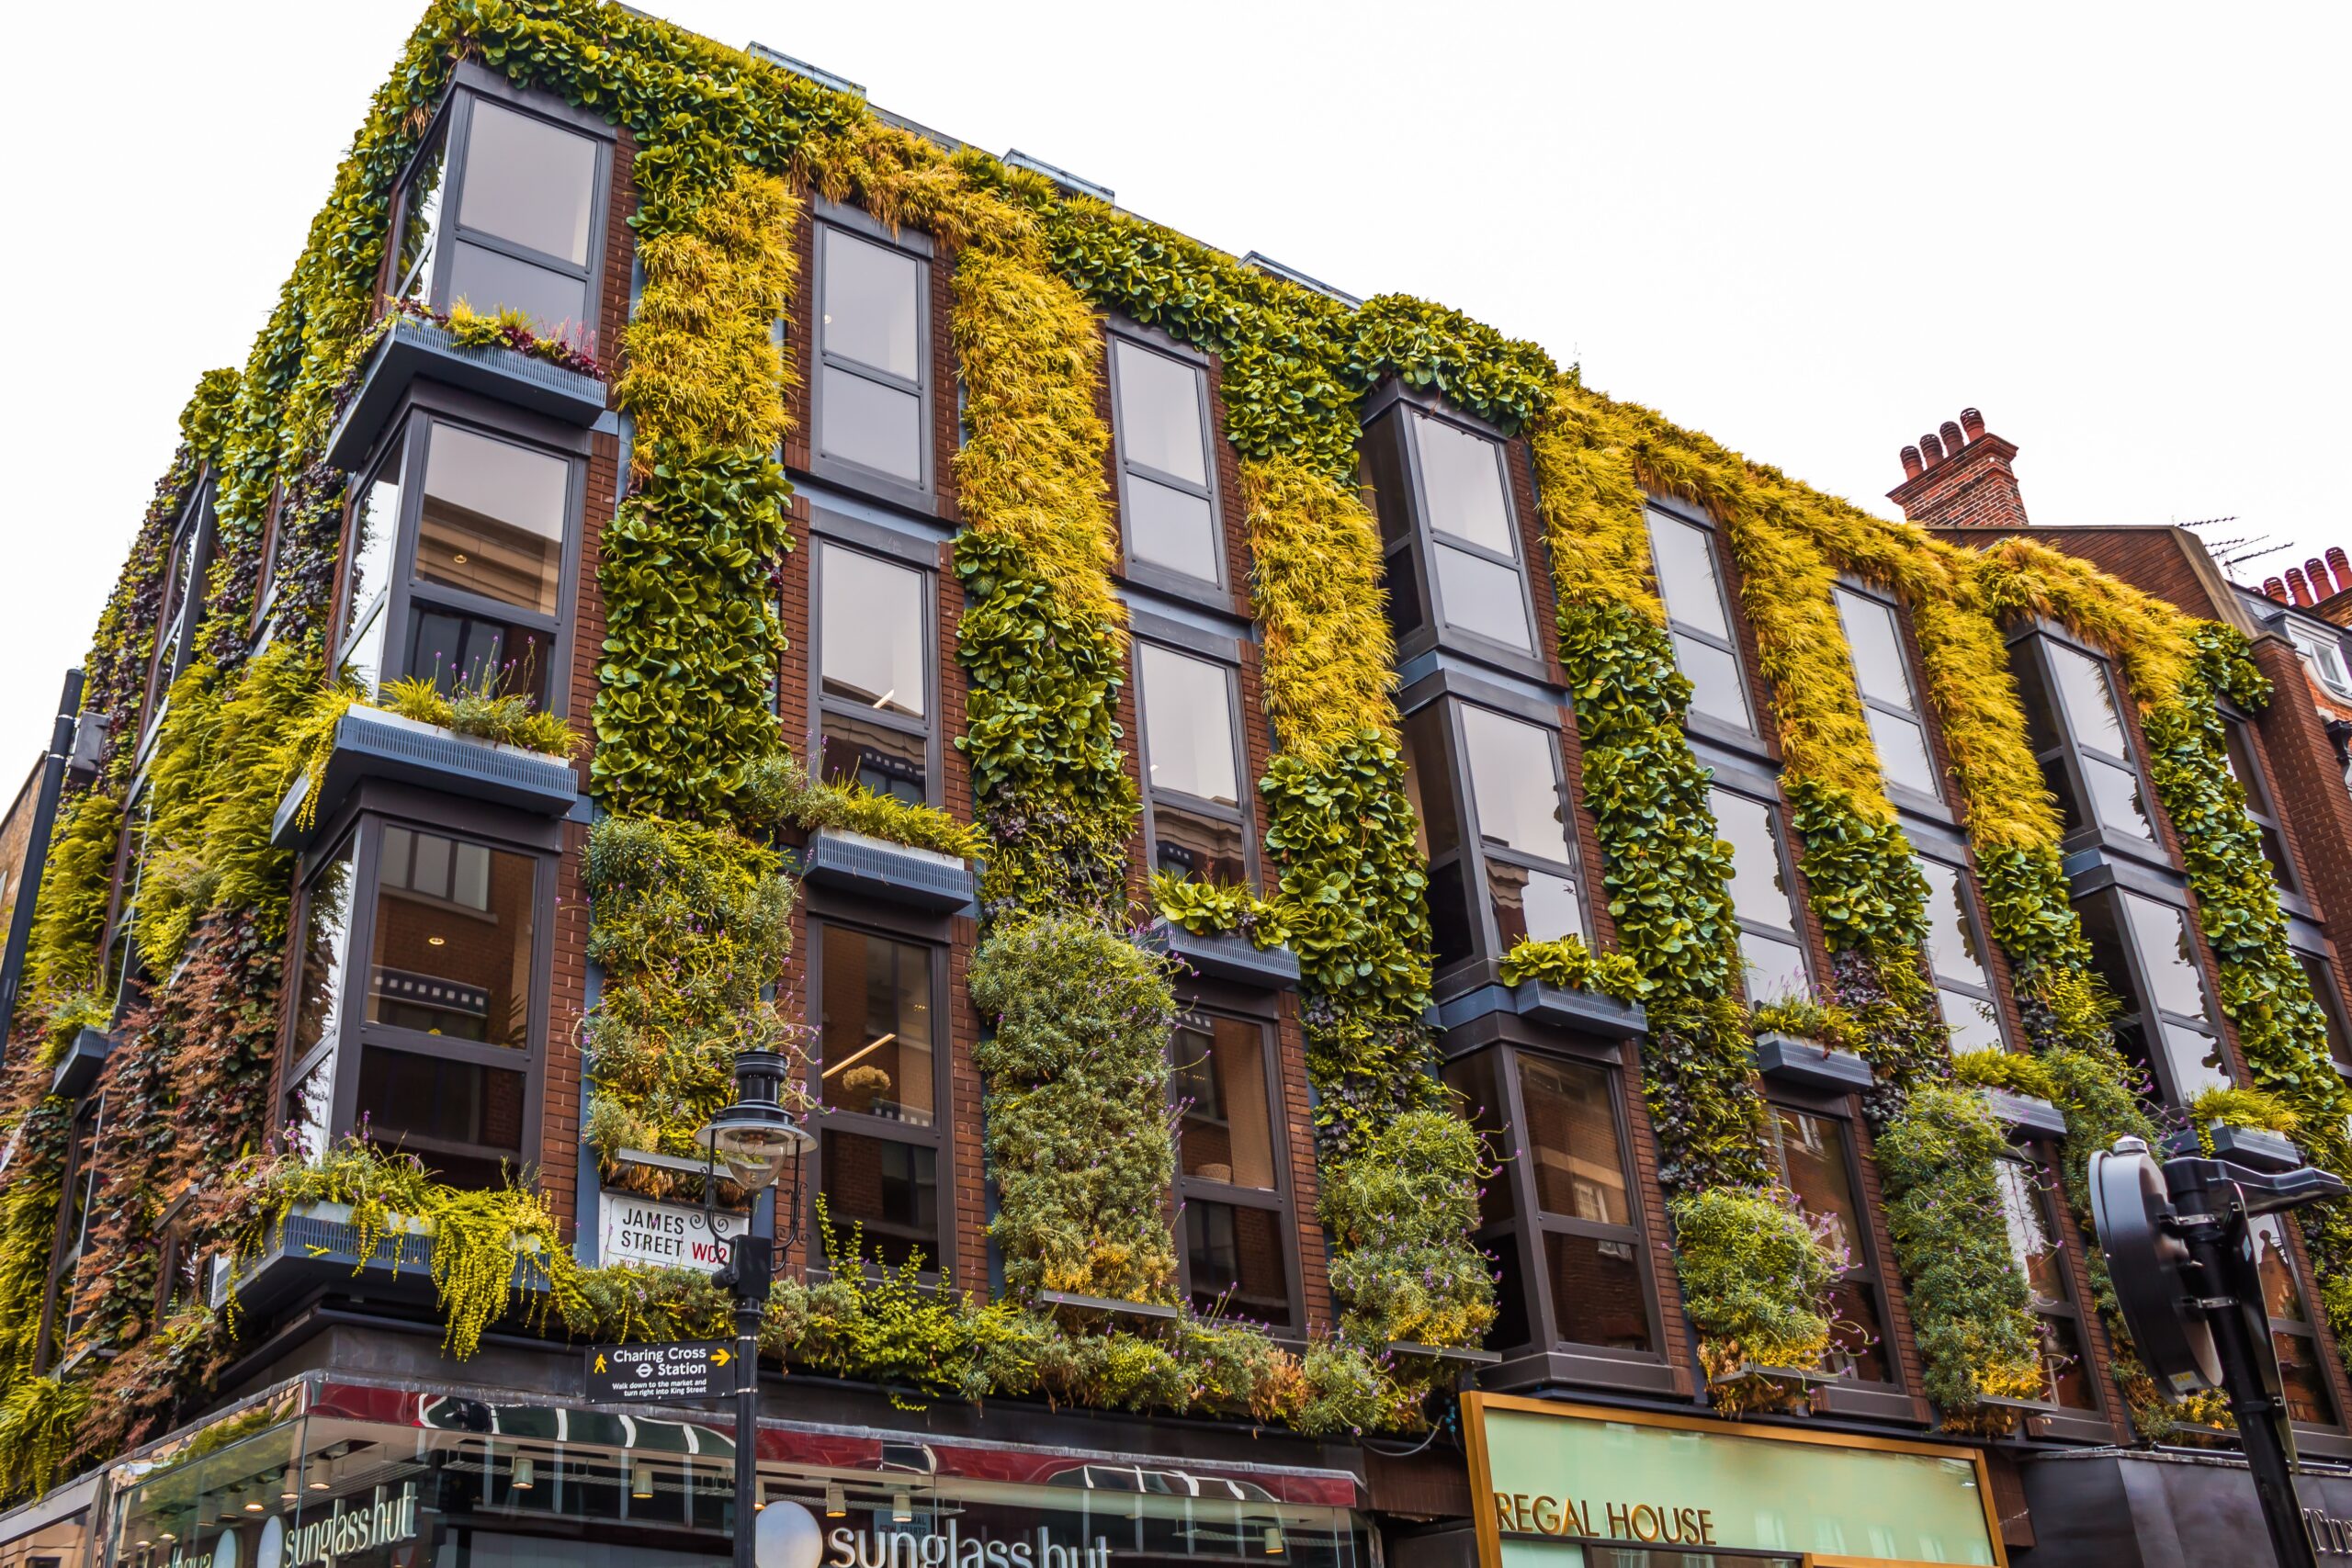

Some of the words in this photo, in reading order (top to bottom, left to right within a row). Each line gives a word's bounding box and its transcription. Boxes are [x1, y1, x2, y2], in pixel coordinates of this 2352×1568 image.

[622, 1208, 684, 1235] JAMES
[620, 1230, 684, 1257] STREET
[692, 1242, 729, 1266] WC2
[613, 1348, 664, 1363] Charing
[668, 1347, 707, 1360] Cross
[658, 1361, 707, 1376] Station
[612, 1382, 628, 1390] Walk
[629, 1381, 648, 1389] down
[657, 1380, 670, 1388] the
[671, 1380, 693, 1388] market
[639, 1388, 654, 1397] right
[655, 1387, 669, 1395] into
[670, 1387, 685, 1395] King
[685, 1385, 707, 1393] Street
[1494, 1492, 1600, 1537] REGAL
[1606, 1502, 1717, 1546] HOUSE
